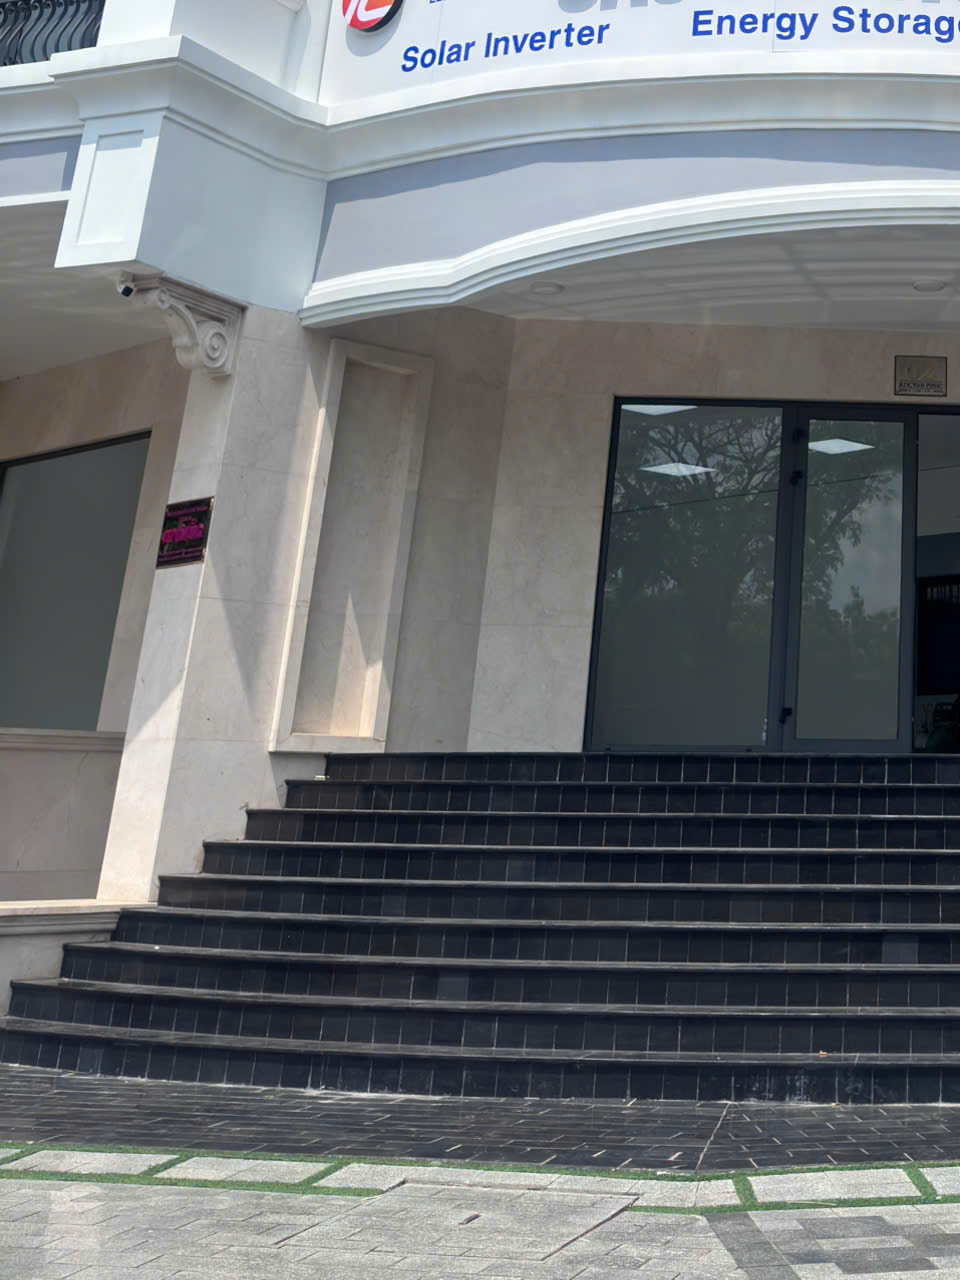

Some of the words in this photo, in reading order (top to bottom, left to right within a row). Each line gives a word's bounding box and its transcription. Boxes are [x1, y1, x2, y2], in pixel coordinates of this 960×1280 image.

[692, 10, 818, 40] Energy
[401, 41, 475, 72] Solar
[485, 23, 610, 58] Inverter
